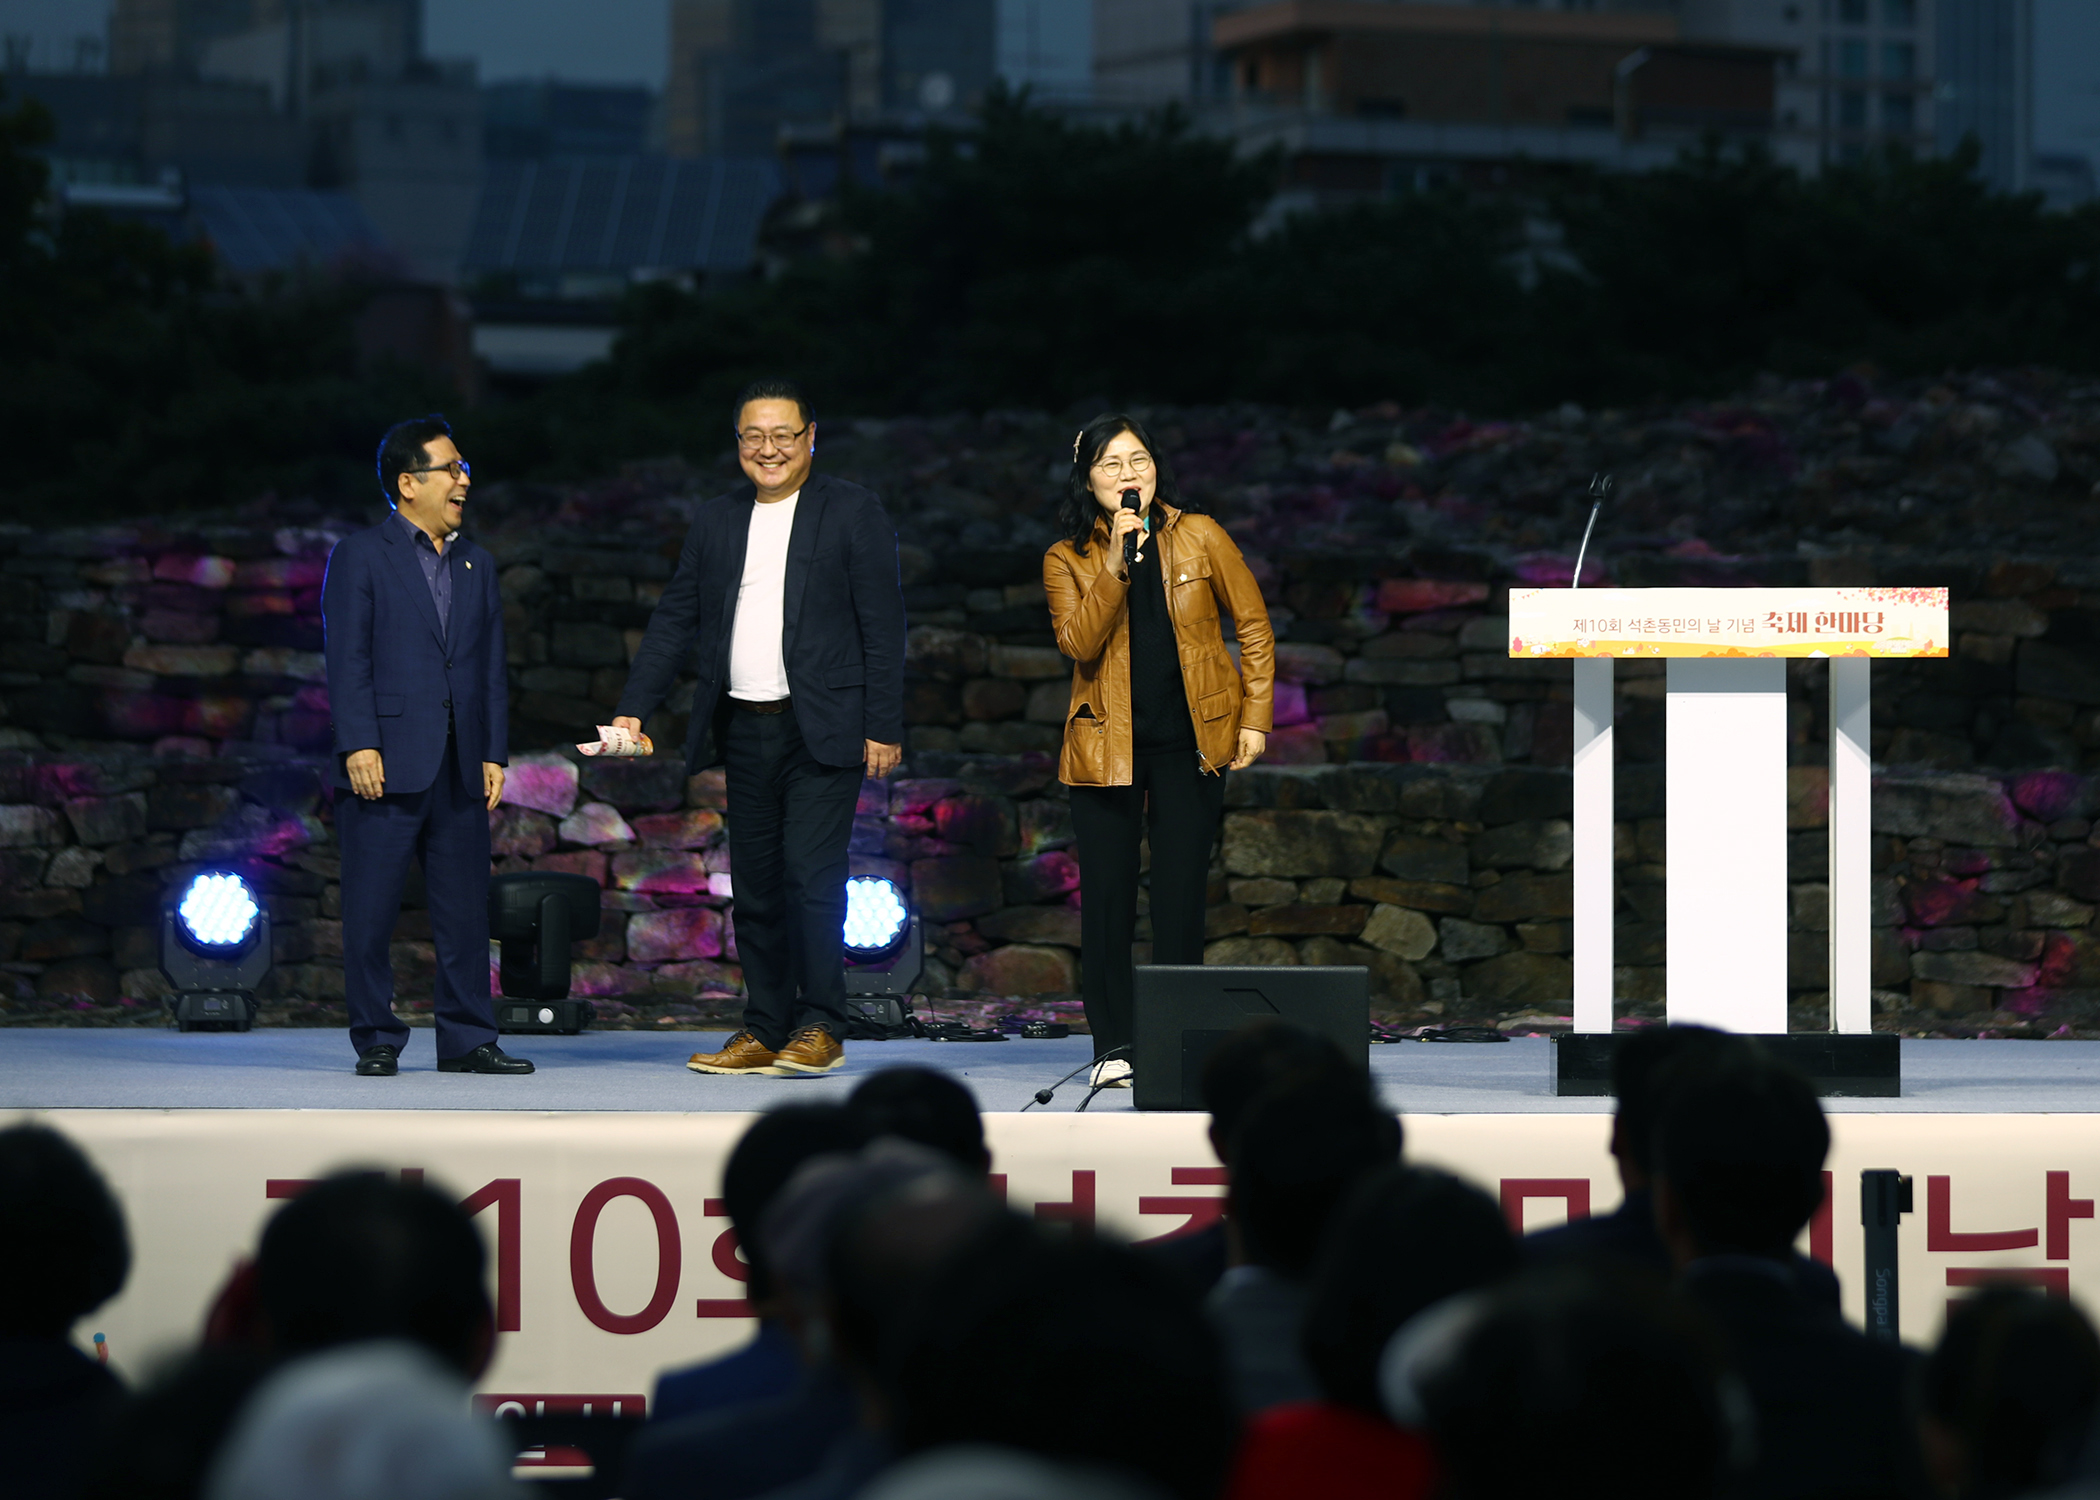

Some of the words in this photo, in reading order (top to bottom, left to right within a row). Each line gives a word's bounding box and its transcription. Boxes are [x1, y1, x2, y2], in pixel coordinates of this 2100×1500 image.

[1573, 618, 1622, 634] 제10회
[1628, 617, 1701, 634] 석촌동민의
[1707, 618, 1721, 634] 날
[1727, 618, 1755, 634] 기념
[1762, 611, 1808, 634] 축제
[1815, 611, 1885, 634] 한마당
